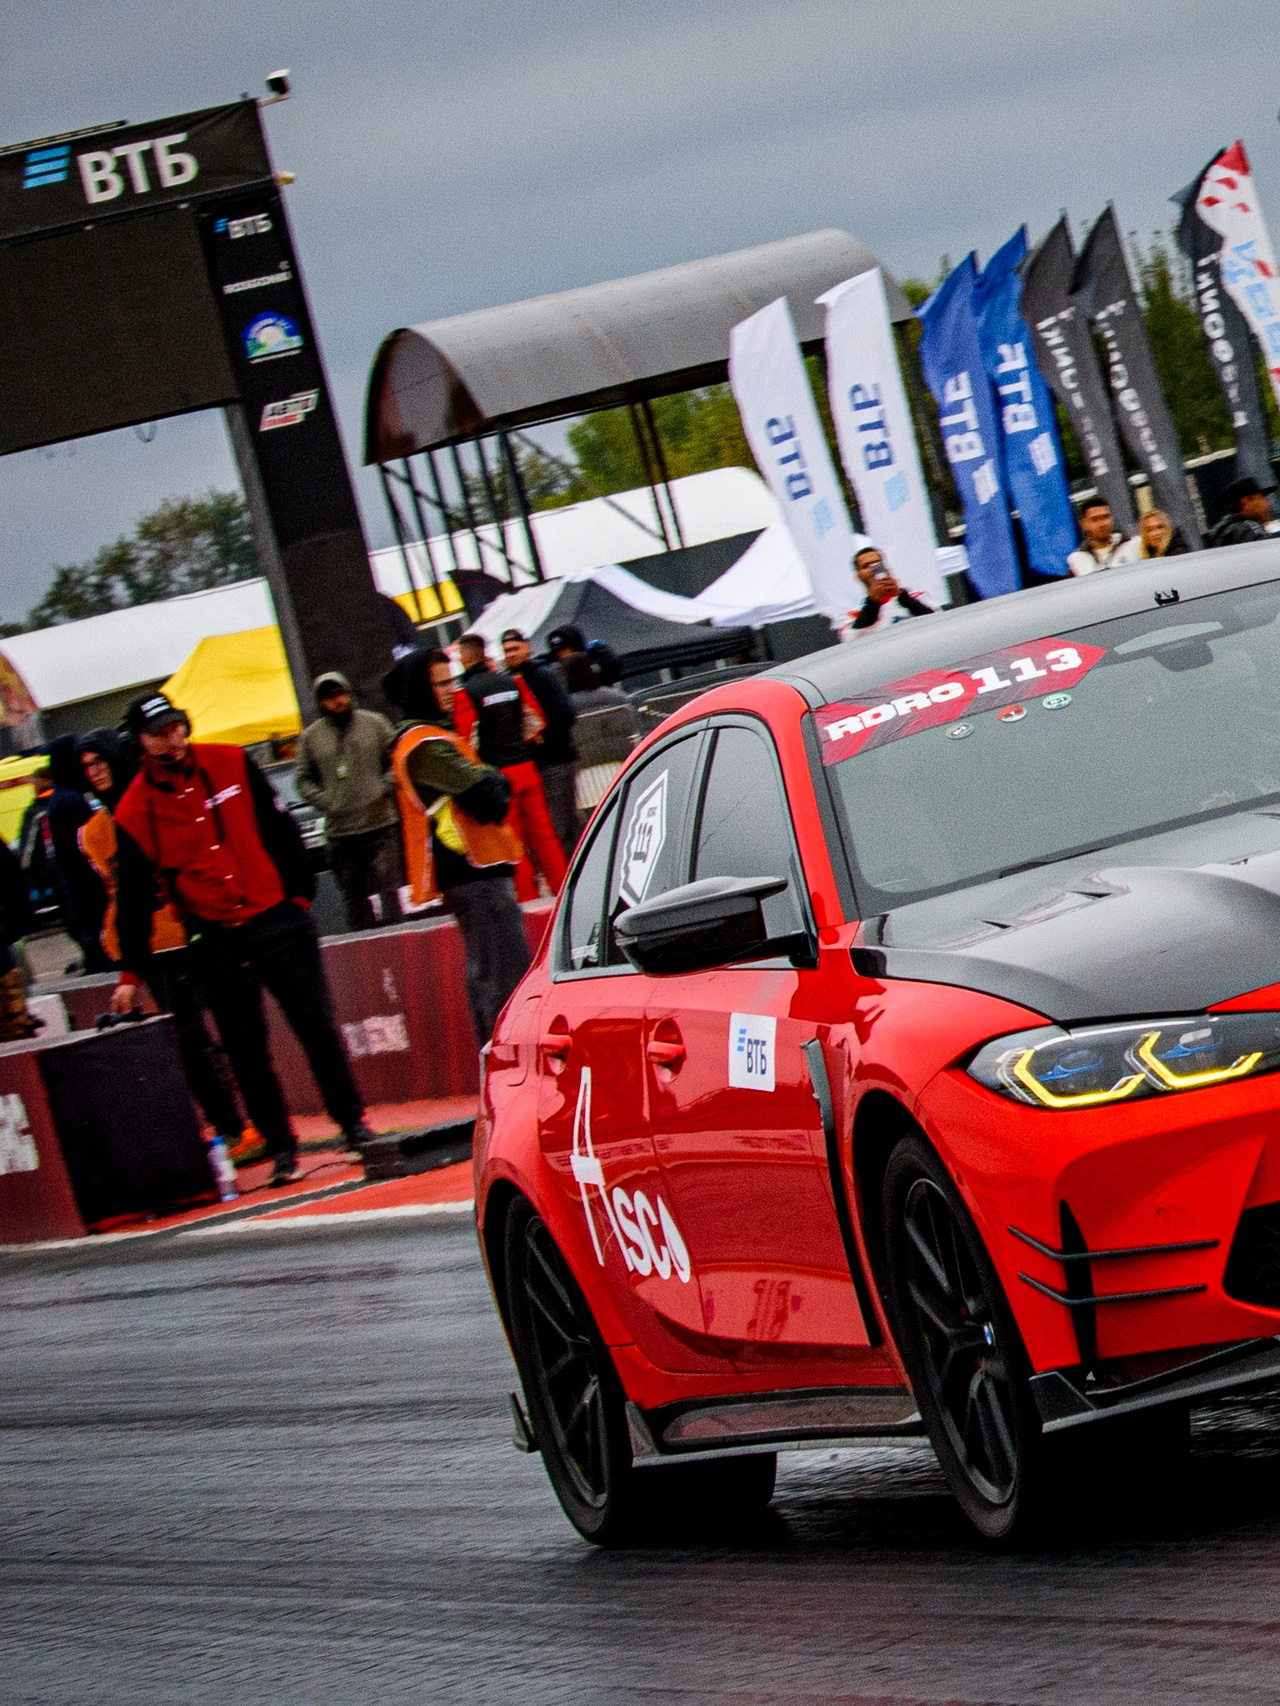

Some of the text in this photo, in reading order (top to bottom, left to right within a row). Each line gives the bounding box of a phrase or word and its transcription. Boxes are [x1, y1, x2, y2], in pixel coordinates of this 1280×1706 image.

[76, 133, 200, 205] ВТБ
[970, 647, 1082, 695] 113
[747, 1038, 768, 1075] ВТБ
